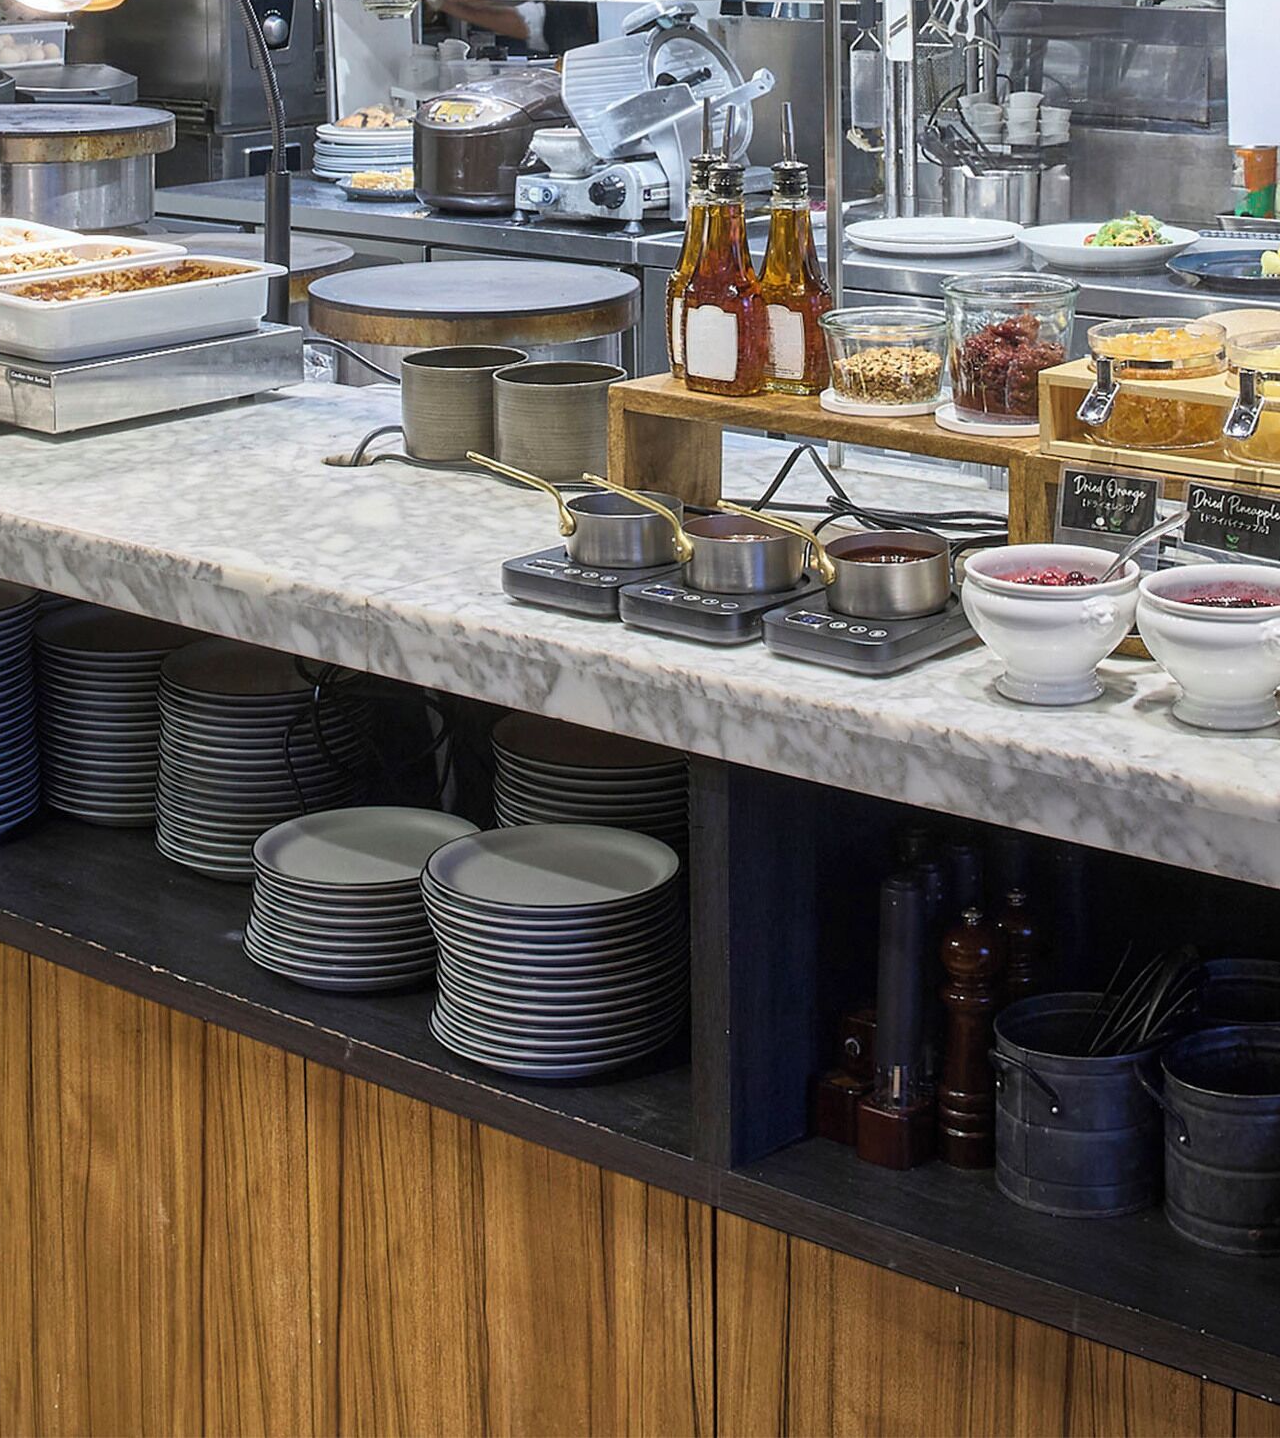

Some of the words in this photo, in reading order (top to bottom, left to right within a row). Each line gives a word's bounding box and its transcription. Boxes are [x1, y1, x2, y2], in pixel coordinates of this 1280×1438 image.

[1073, 475, 1104, 497] Dried
[1106, 478, 1147, 507] Orange
[1192, 488, 1225, 513] Dried
